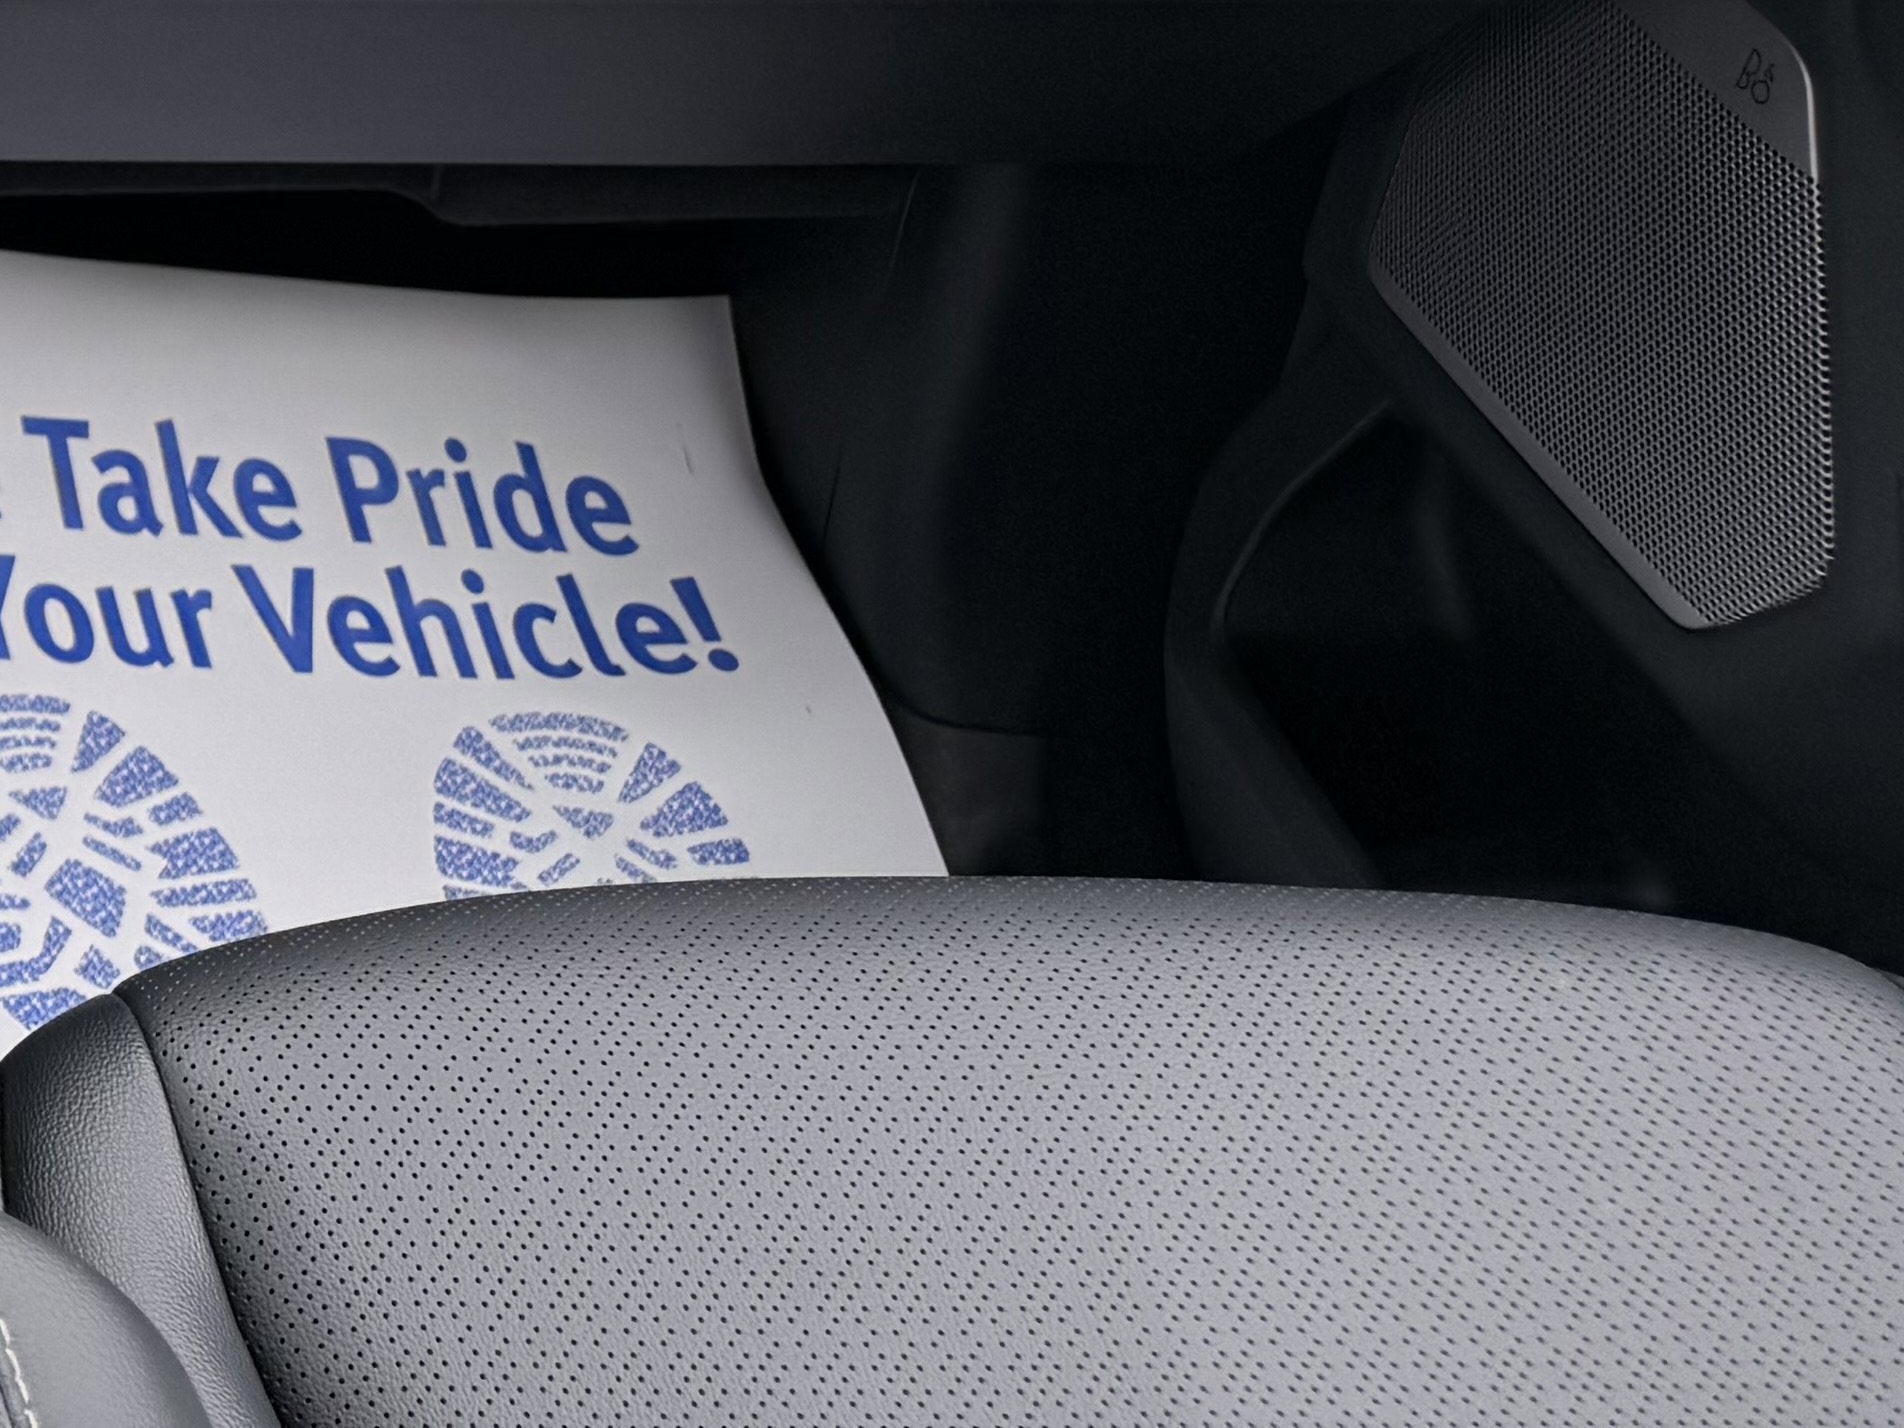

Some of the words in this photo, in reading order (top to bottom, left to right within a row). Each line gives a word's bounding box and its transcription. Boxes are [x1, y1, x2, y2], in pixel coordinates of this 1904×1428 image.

[19, 416, 305, 542] Take
[324, 433, 641, 558] Pride
[231, 562, 742, 681] Vehicle!
